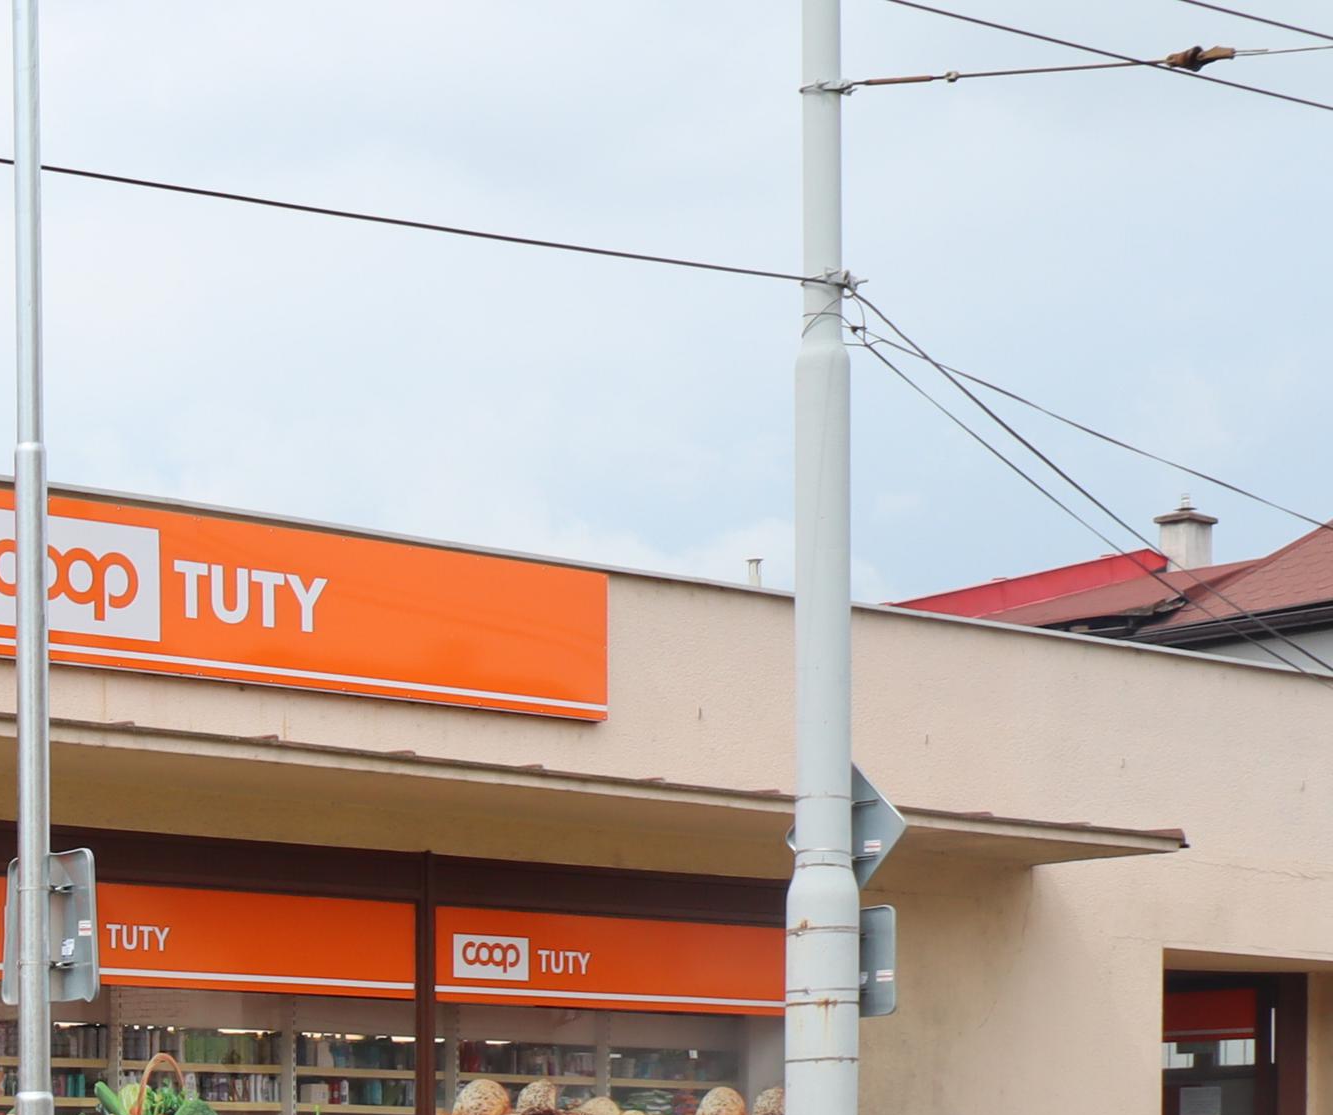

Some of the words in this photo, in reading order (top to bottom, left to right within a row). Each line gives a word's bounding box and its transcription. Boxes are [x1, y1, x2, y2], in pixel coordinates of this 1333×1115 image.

[172, 559, 329, 633] TUTY
[105, 923, 171, 951] TUTY
[462, 941, 520, 973] coop
[537, 949, 591, 974] TUTY
